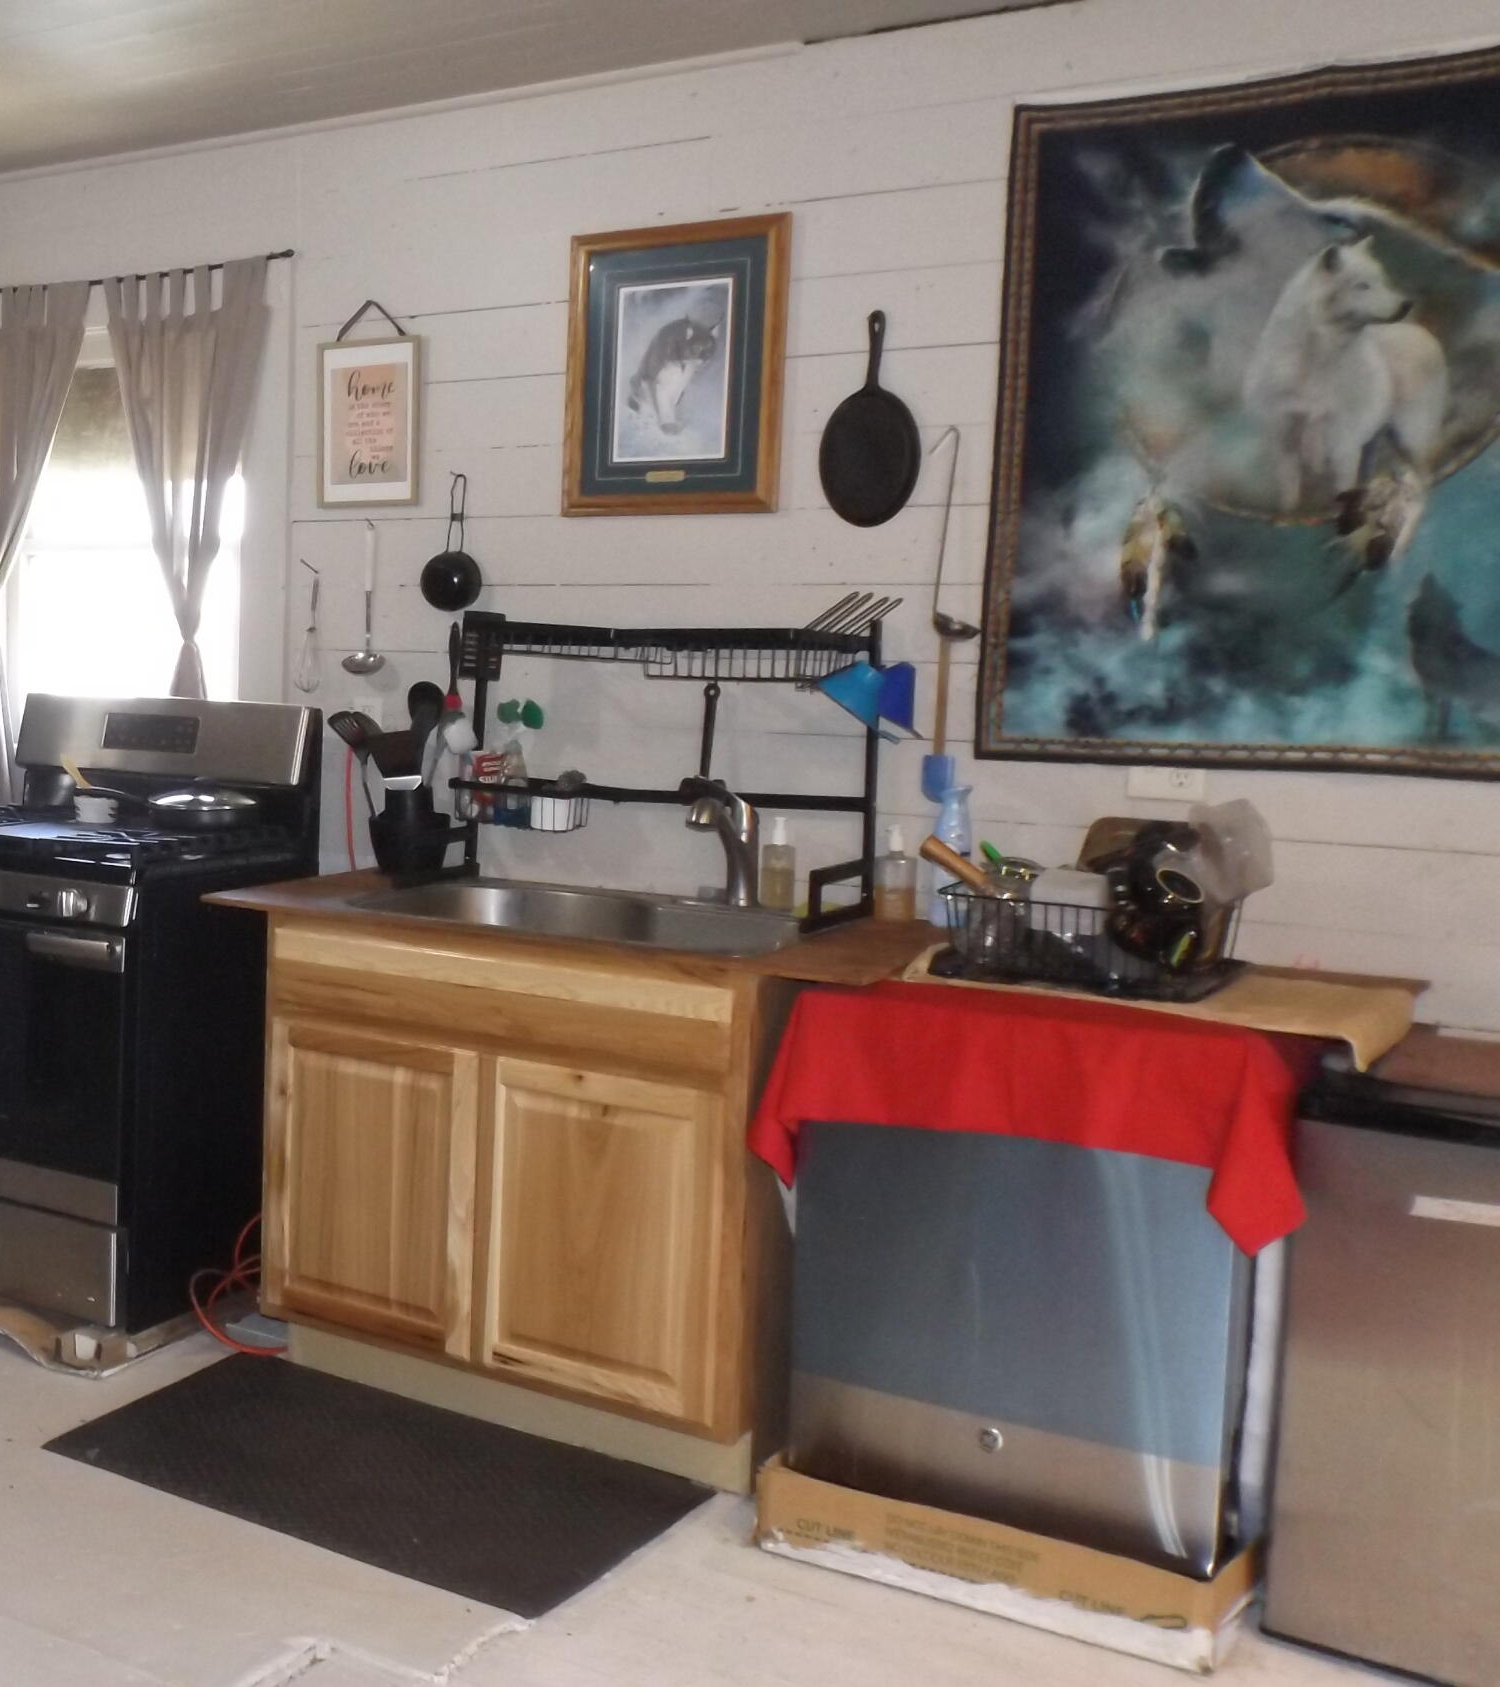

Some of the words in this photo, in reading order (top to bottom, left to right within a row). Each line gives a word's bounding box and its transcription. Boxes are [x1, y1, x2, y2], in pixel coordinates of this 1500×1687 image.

[347, 369, 396, 401] home
[348, 448, 390, 480] love
[796, 1518, 821, 1533] CUT
